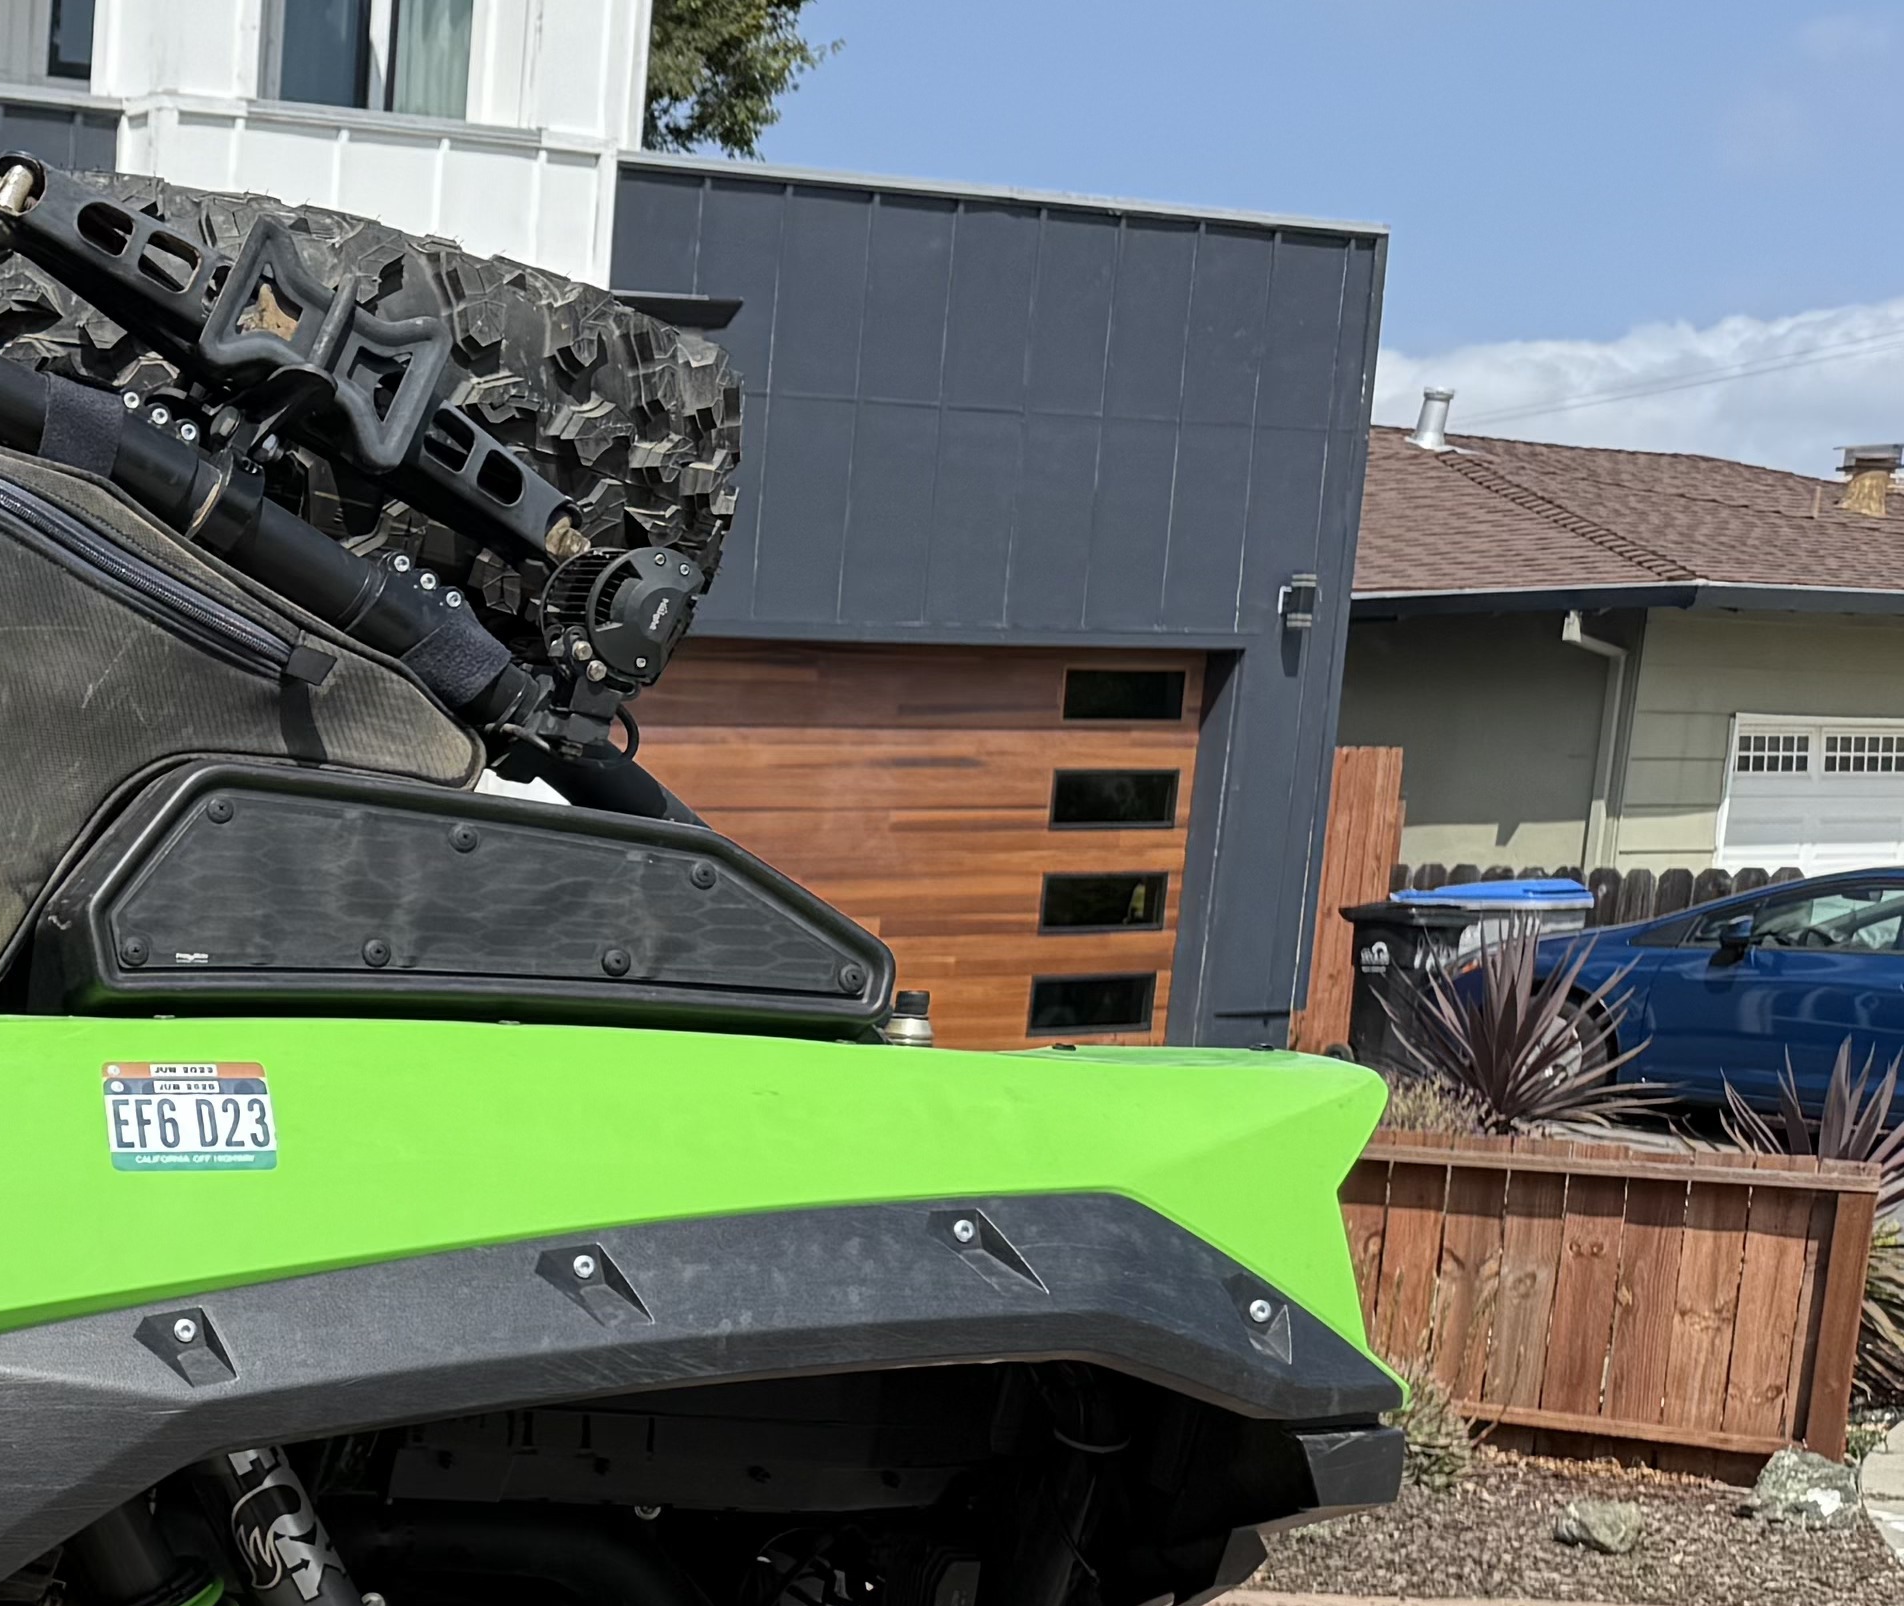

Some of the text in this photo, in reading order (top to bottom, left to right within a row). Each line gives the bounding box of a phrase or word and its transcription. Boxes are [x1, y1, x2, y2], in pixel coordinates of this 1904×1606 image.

[112, 1098, 270, 1149] EF6 D23
[135, 1155, 190, 1163] CALIFORNIA
